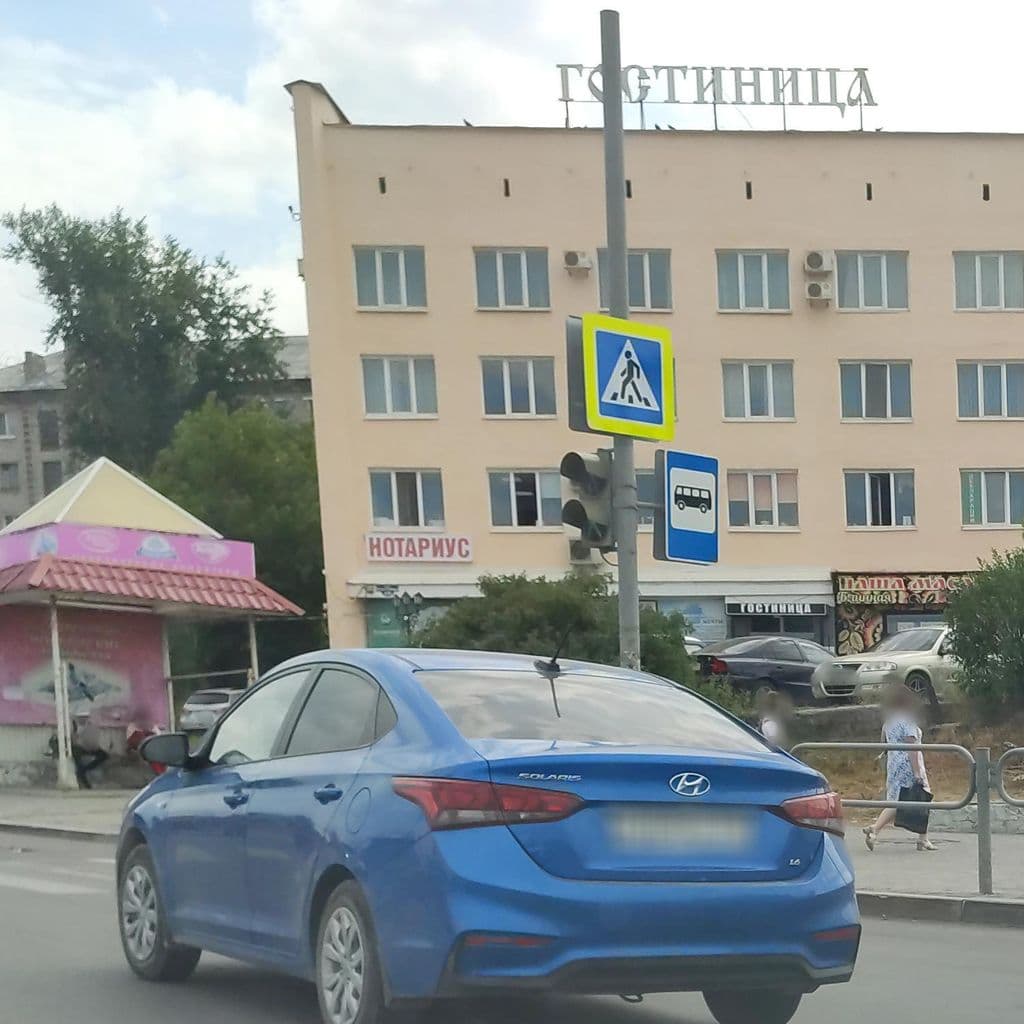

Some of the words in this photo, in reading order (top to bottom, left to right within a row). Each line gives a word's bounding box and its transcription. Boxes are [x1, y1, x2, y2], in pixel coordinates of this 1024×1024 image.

[368, 537, 470, 558] НОТАРИУС
[740, 603, 811, 614] ГОСТИНИЦА
[518, 772, 583, 782] SOLARIS
